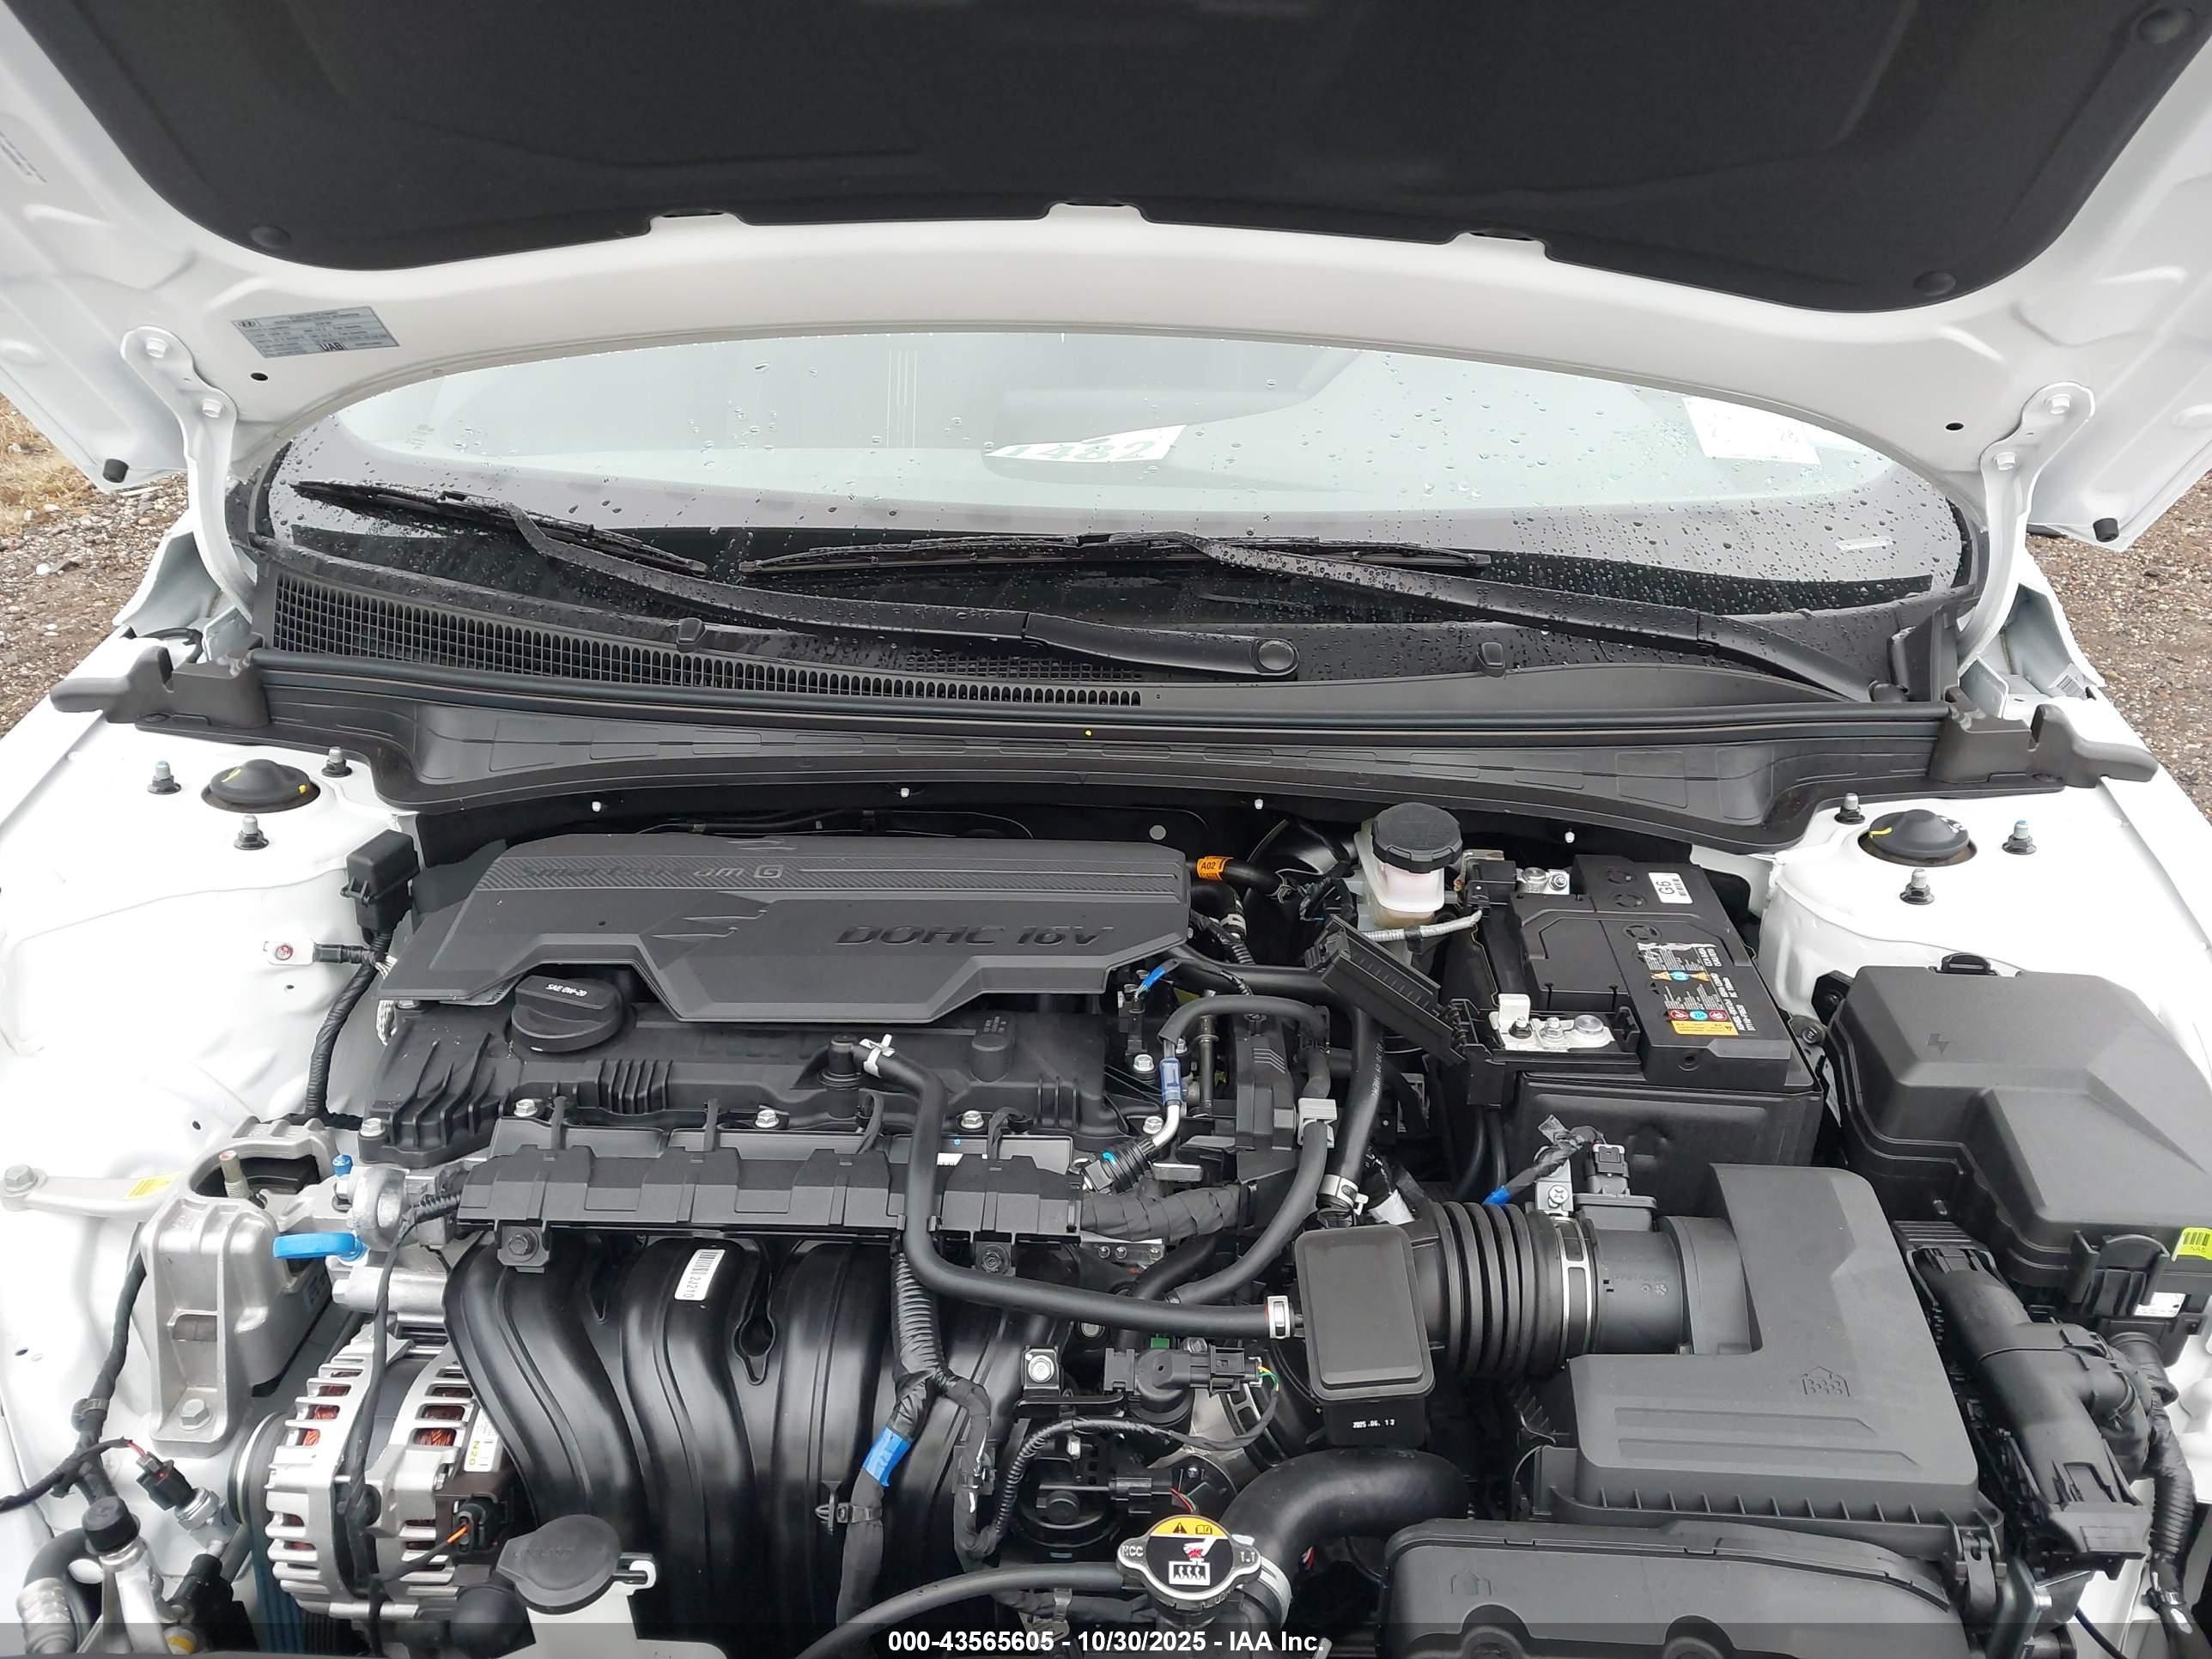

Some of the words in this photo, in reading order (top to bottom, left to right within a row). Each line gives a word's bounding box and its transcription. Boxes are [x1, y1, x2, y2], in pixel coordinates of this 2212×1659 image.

[1200, 861, 1216, 871] A02
[1656, 881, 1675, 894] G6
[835, 925, 1006, 945] DOHC
[1016, 925, 1114, 945] 16V
[562, 988, 587, 997] 0W-20
